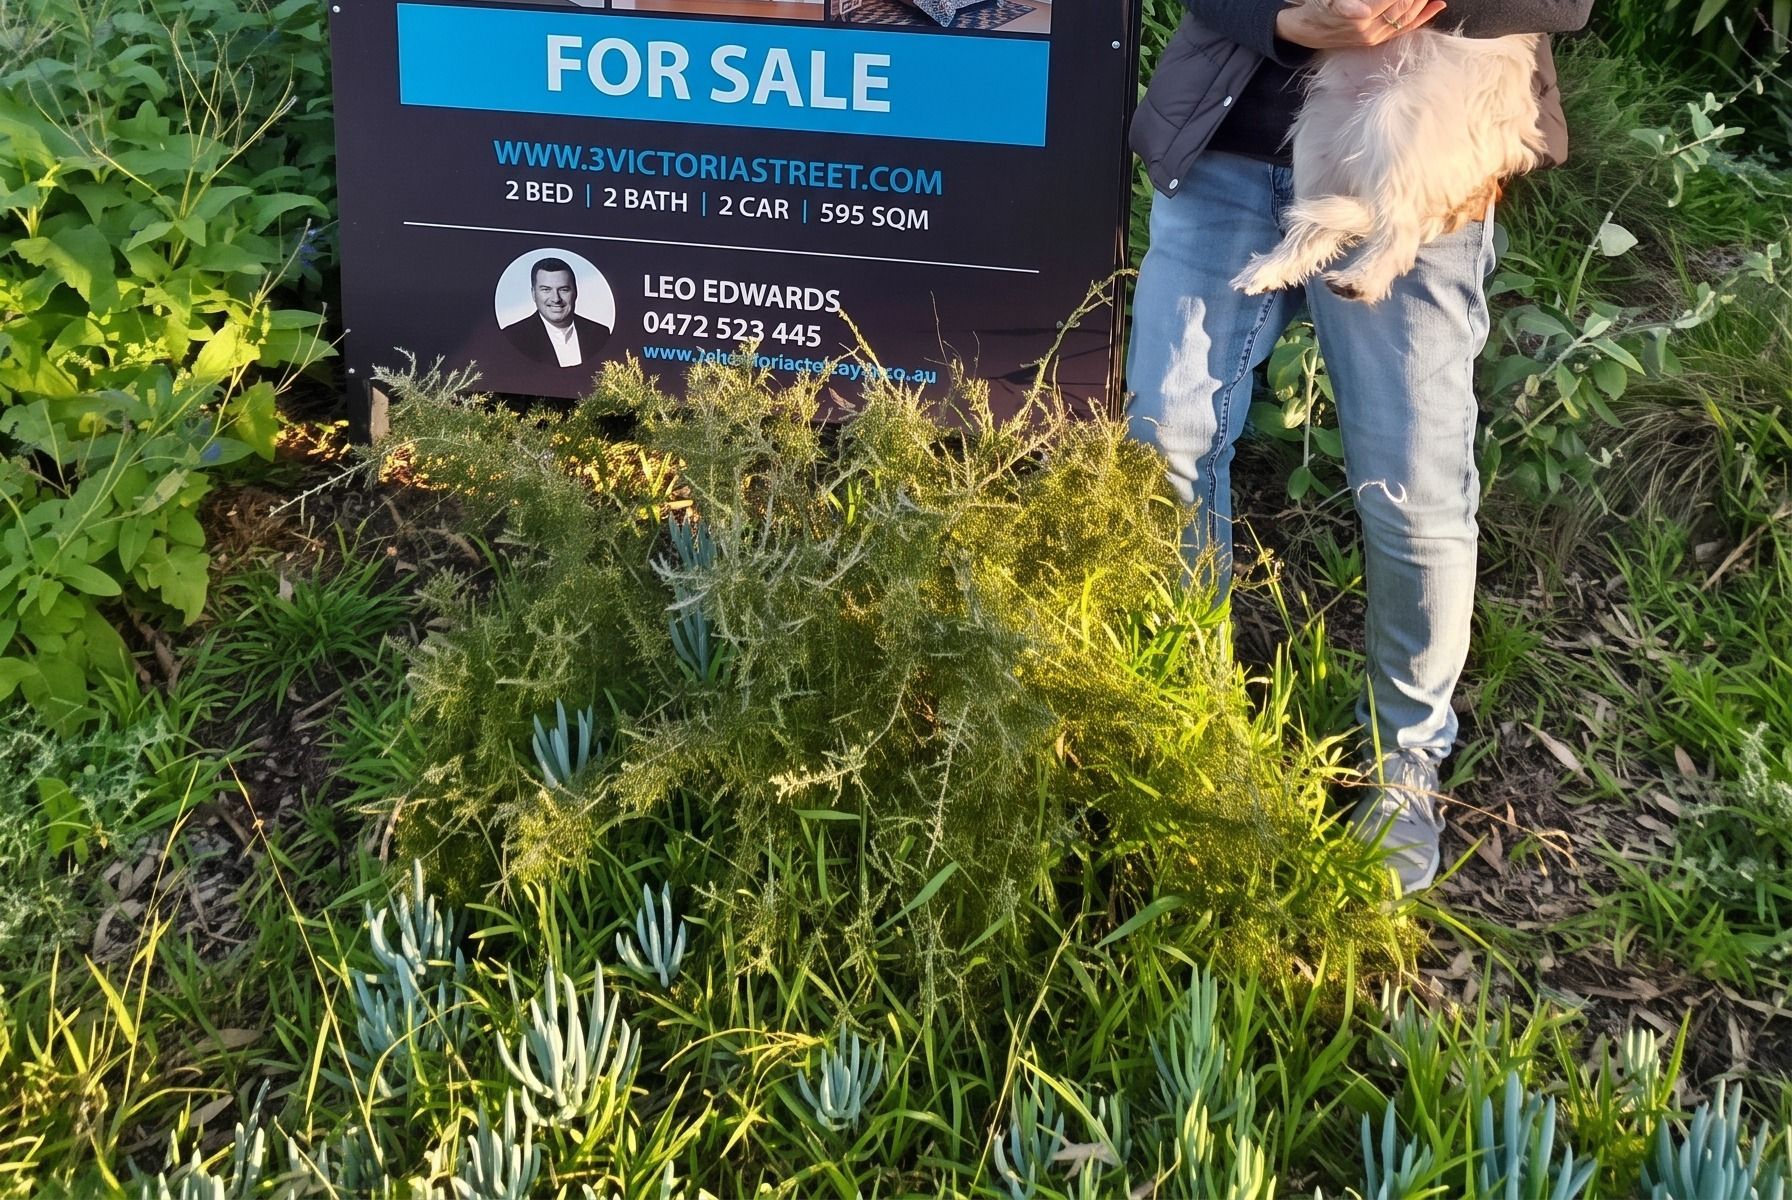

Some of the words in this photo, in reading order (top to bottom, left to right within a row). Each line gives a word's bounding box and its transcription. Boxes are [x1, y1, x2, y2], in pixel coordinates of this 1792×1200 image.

[548, 35, 689, 99] FOR
[711, 45, 889, 112] SALE
[494, 140, 943, 195] WWW.3VICTORIASTREET.COM
[506, 181, 519, 199] 2
[527, 182, 573, 203] BED
[604, 188, 617, 207] 2
[625, 189, 687, 212] BATH
[719, 196, 732, 215] 2
[740, 197, 788, 219] CAR
[821, 203, 864, 224] 595
[872, 207, 928, 230] SQM
[645, 275, 695, 300] LEO
[704, 280, 841, 313] EDWARDS
[644, 311, 708, 337] 0472
[717, 318, 764, 343] 523
[772, 323, 821, 347] 445
